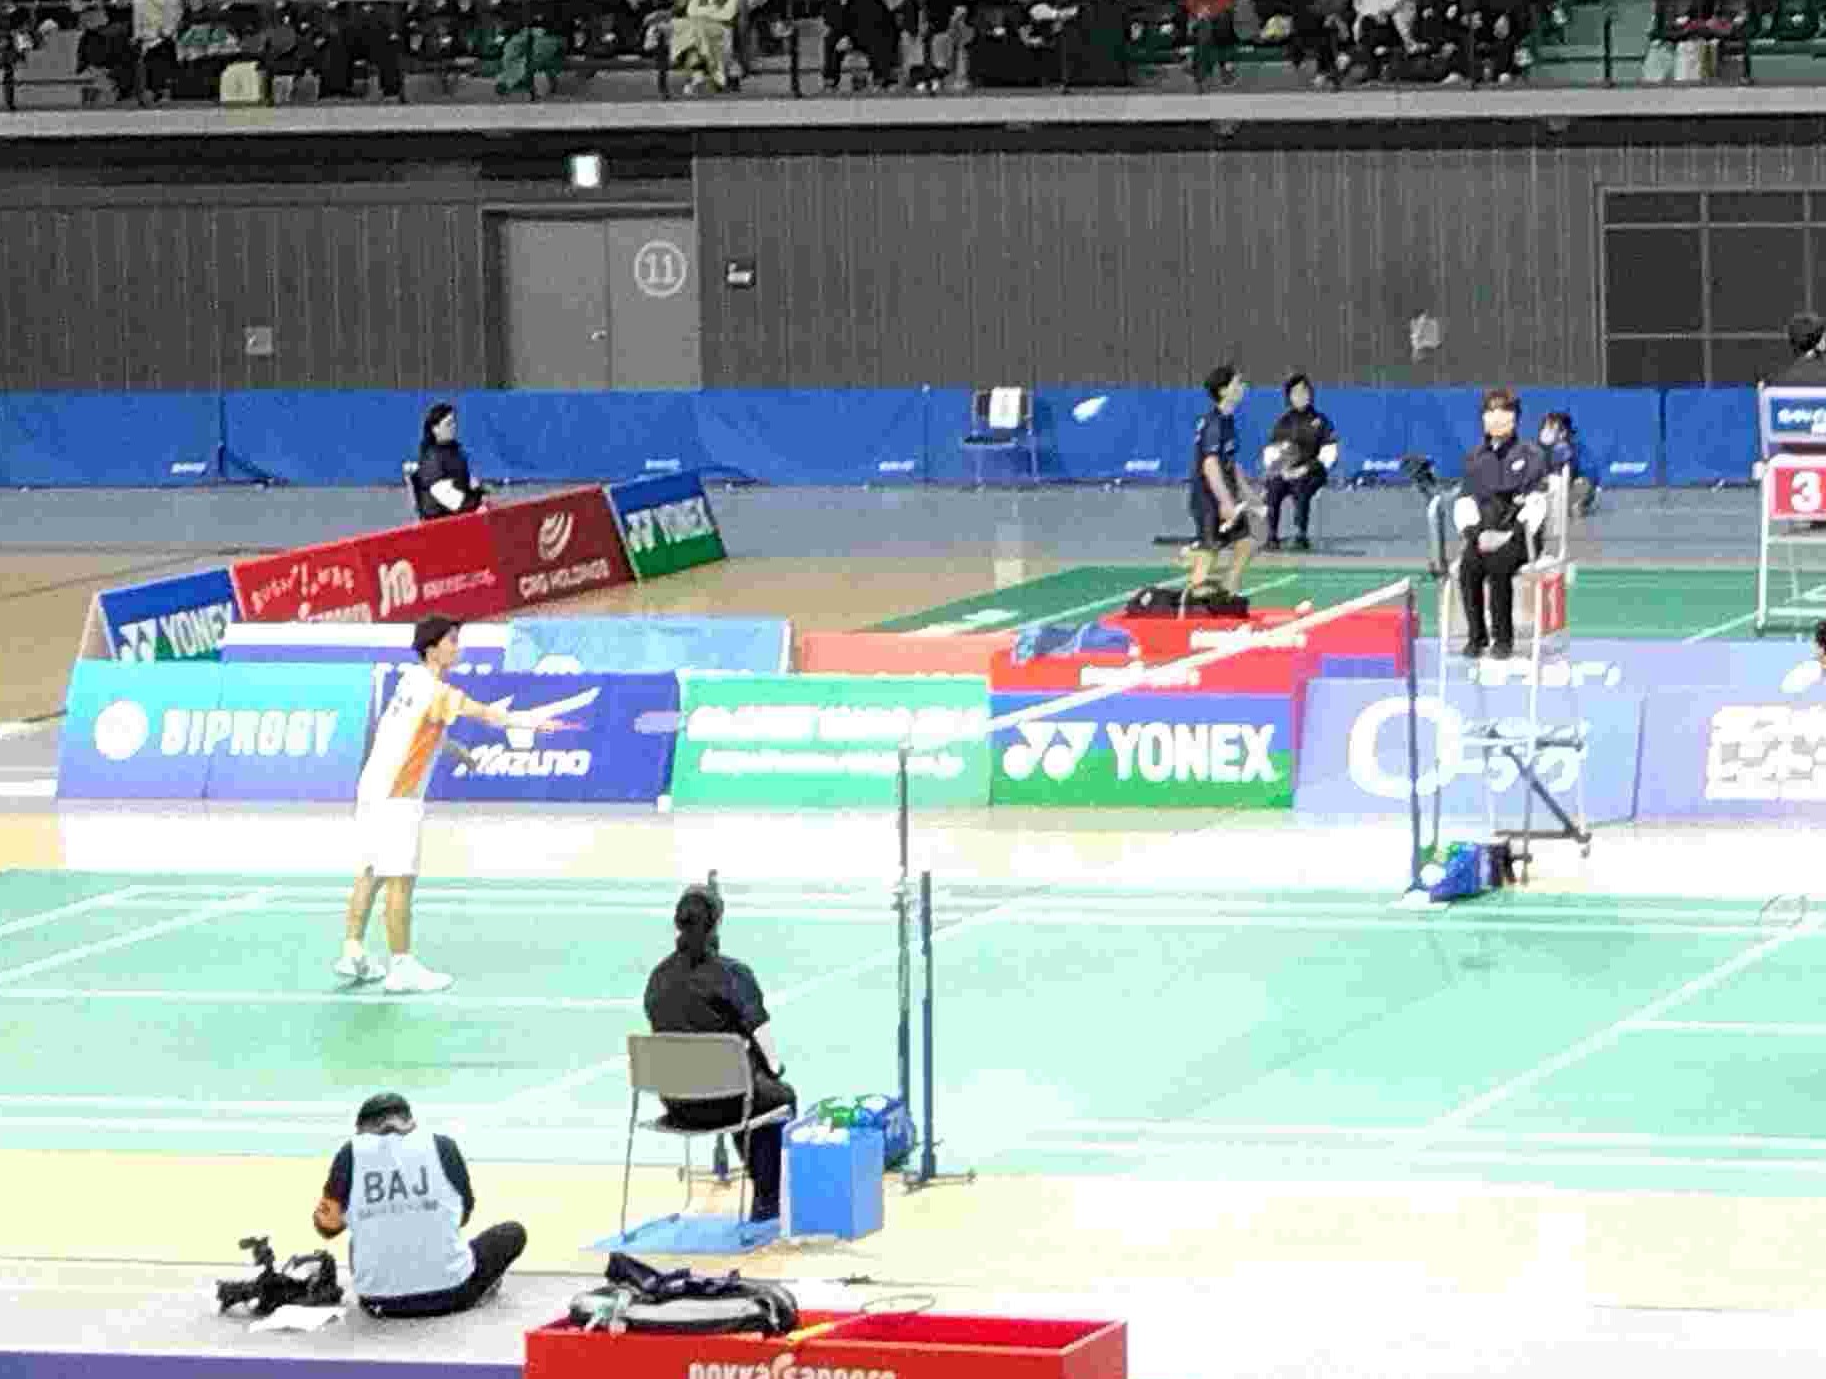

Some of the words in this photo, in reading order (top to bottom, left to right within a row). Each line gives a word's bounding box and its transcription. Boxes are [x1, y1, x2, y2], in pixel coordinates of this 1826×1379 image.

[1791, 471, 1822, 513] 3
[1106, 722, 1277, 782] YONEX
[363, 1165, 429, 1204] BAJ
